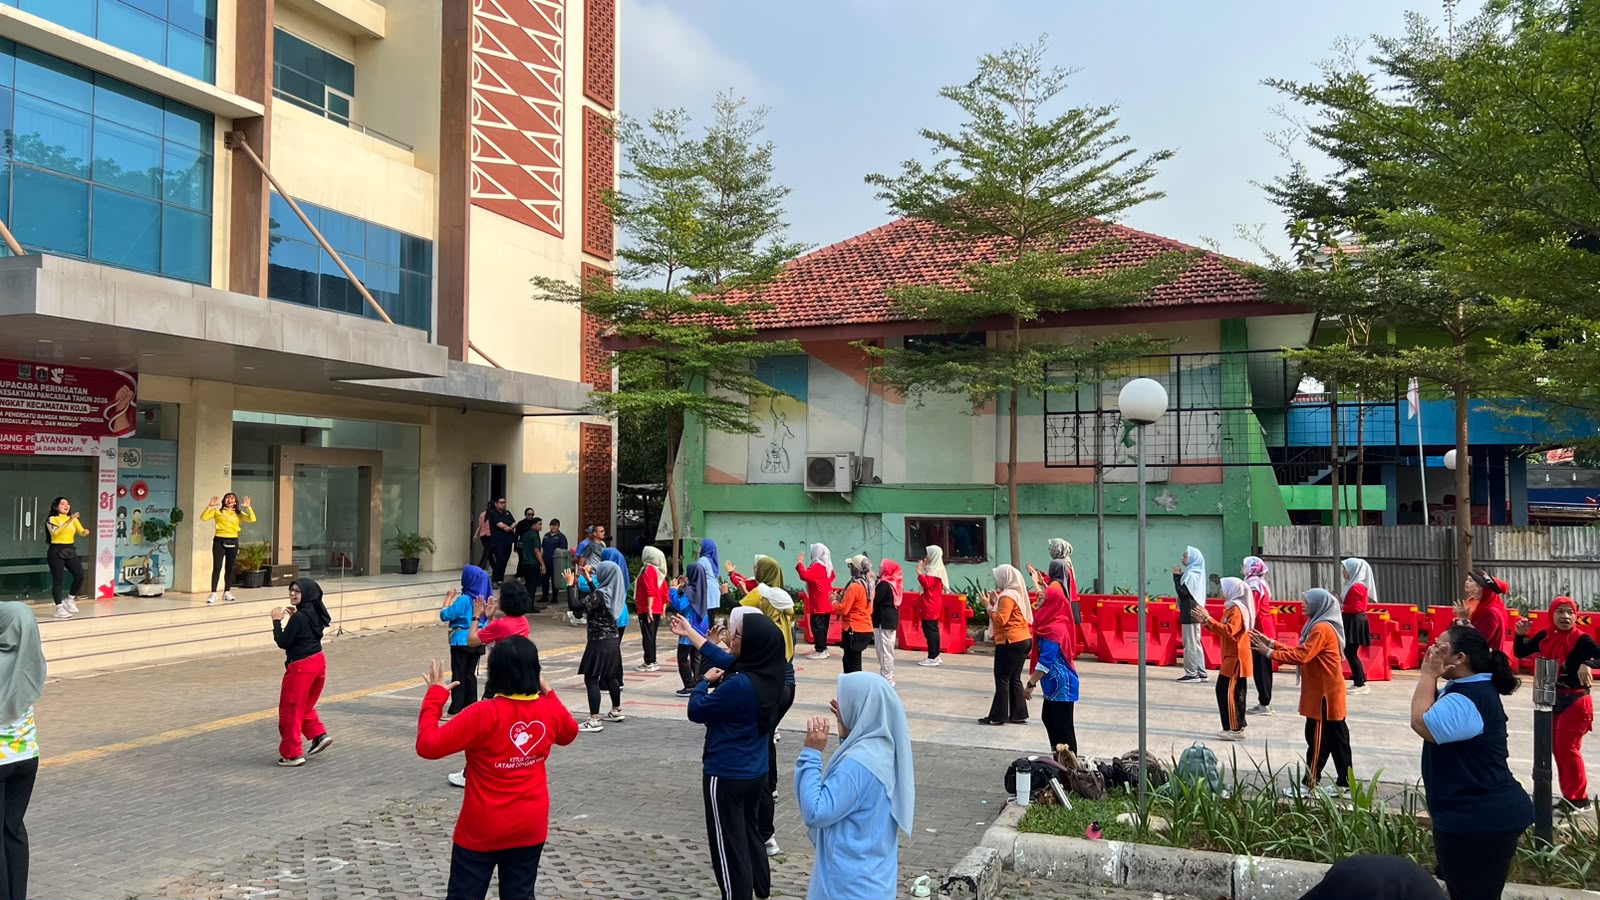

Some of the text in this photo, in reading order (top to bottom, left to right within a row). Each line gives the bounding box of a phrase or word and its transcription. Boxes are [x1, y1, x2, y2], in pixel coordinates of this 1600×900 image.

[41, 384, 88, 395] PERINGATAN
[37, 391, 71, 401] PANCASILA
[72, 395, 93, 403] TAHUN
[27, 401, 69, 410] KECAMATAN
[70, 404, 88, 412] KOJA
[5, 411, 36, 419] PEMERSATU
[25, 434, 73, 444] PELAYANAN
[127, 567, 145, 577] IKD
